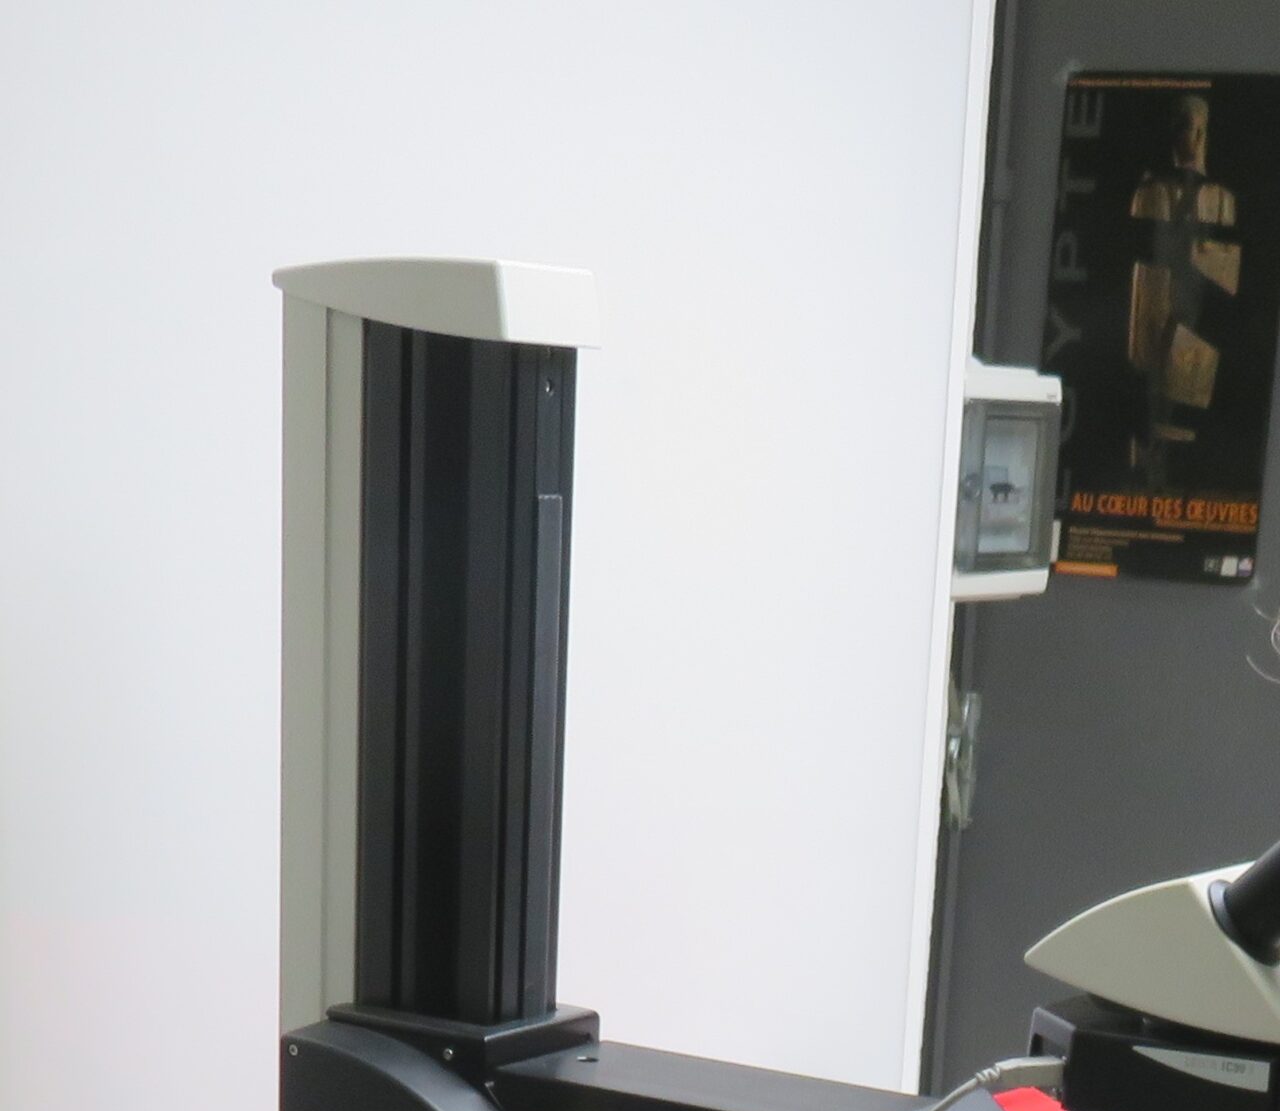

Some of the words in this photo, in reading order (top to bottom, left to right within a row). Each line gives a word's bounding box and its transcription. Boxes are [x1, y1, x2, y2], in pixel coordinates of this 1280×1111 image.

[1071, 491, 1094, 513] AU
[1097, 493, 1149, 517] CŒUR
[1152, 497, 1183, 521] DES
[1187, 499, 1260, 525] ŒUVRES
